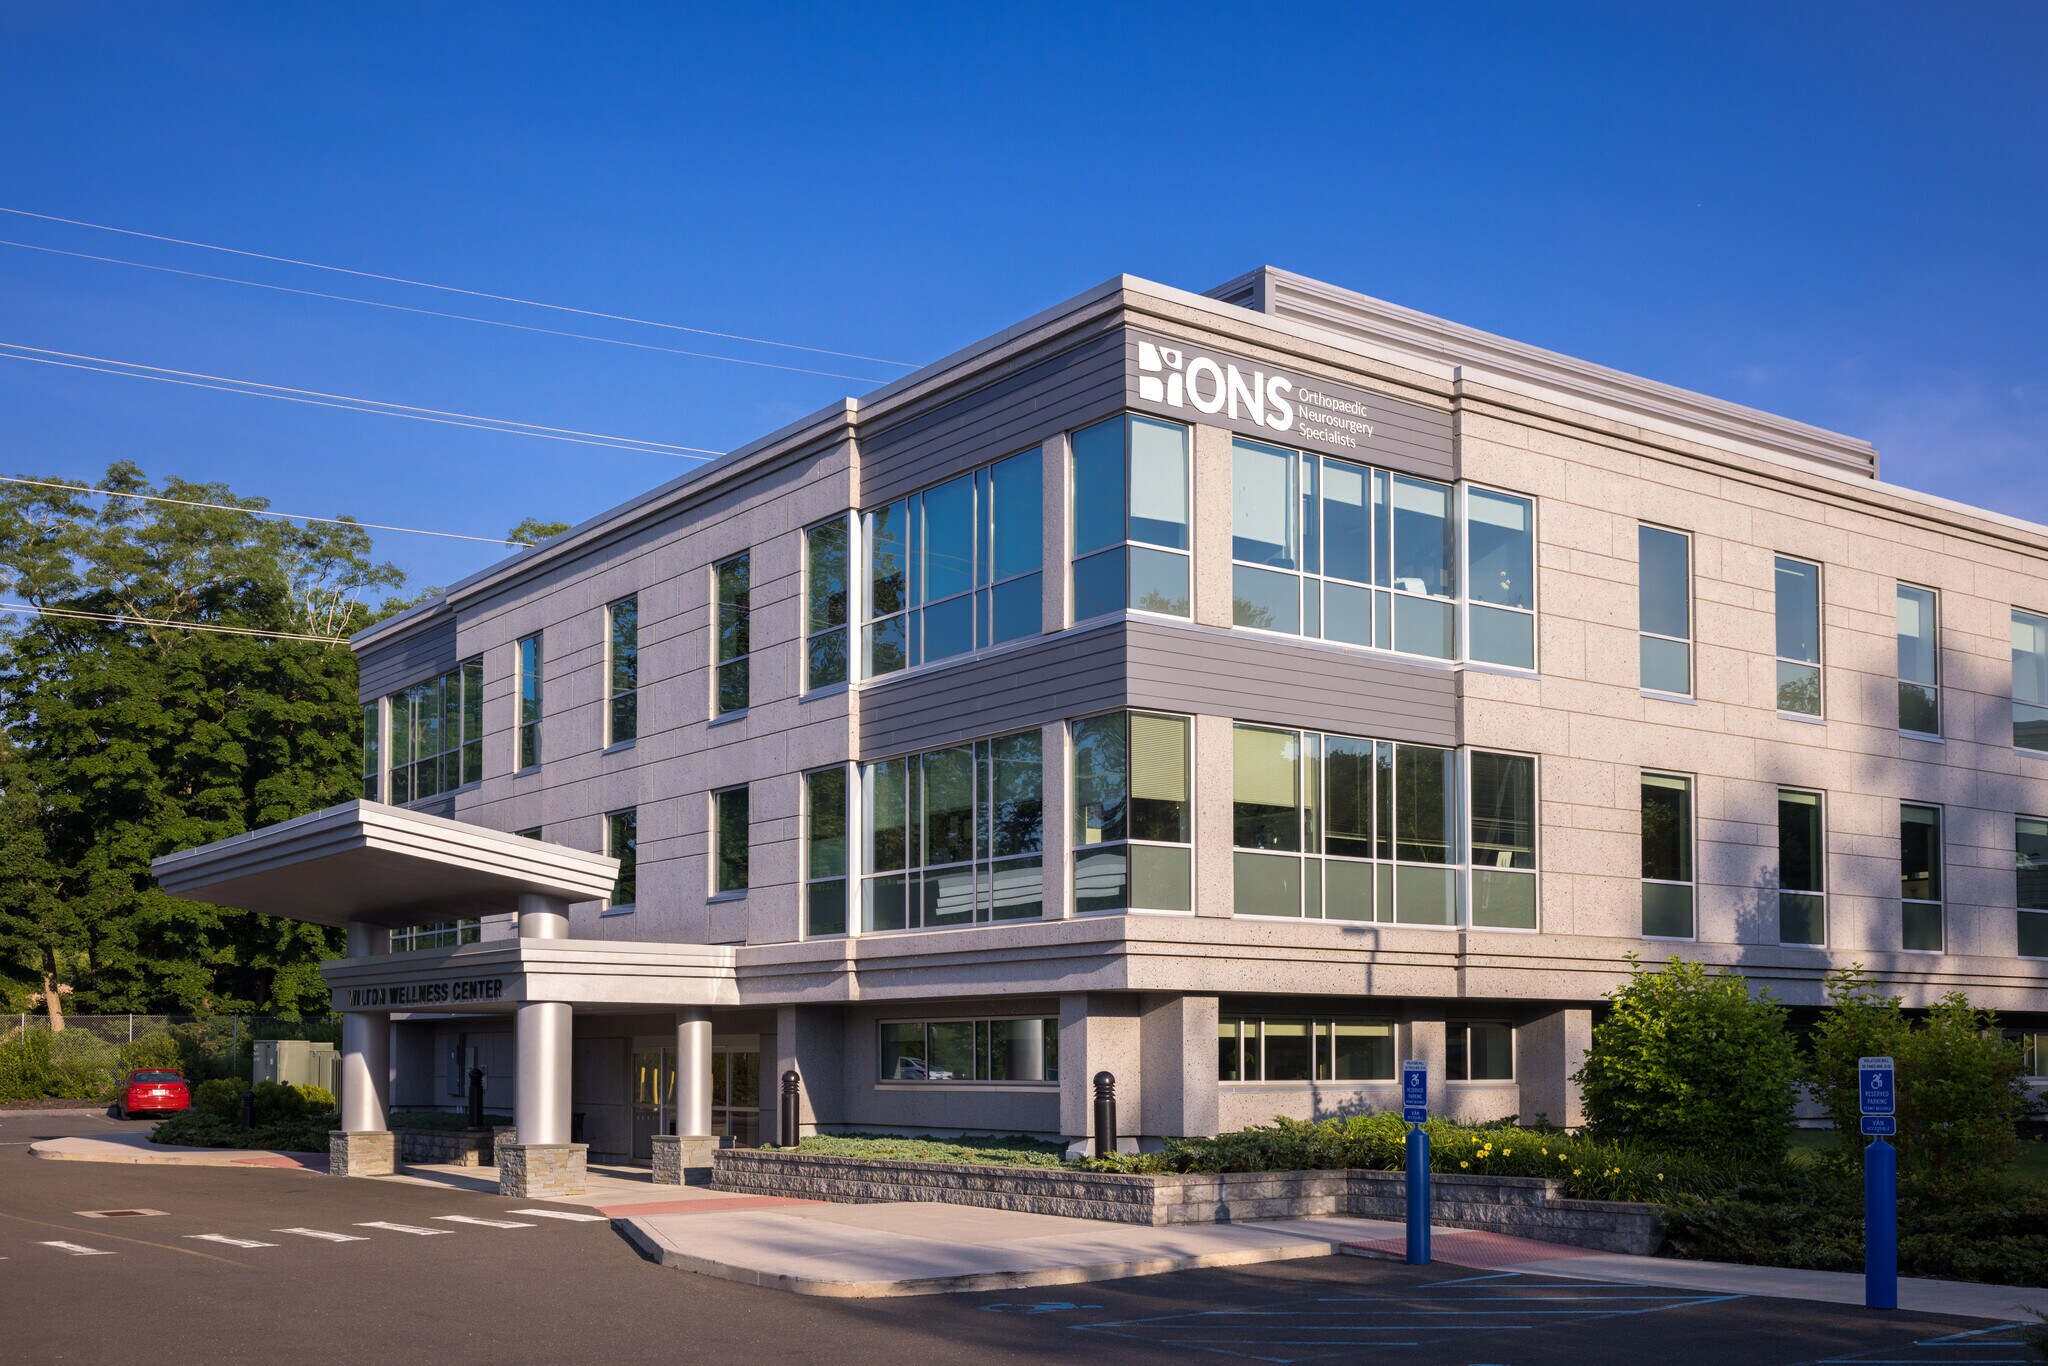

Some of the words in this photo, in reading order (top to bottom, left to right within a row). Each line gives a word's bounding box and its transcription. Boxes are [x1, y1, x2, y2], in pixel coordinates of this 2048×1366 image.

[1185, 356, 1294, 432] ONS
[1299, 387, 1368, 417] Orthopaedic
[1299, 405, 1374, 438] Neurosurgery
[1299, 423, 1357, 449] Specialists
[349, 987, 386, 1007] WILTON
[389, 983, 448, 1005] WELLNESS
[452, 979, 503, 1000] CENTER
